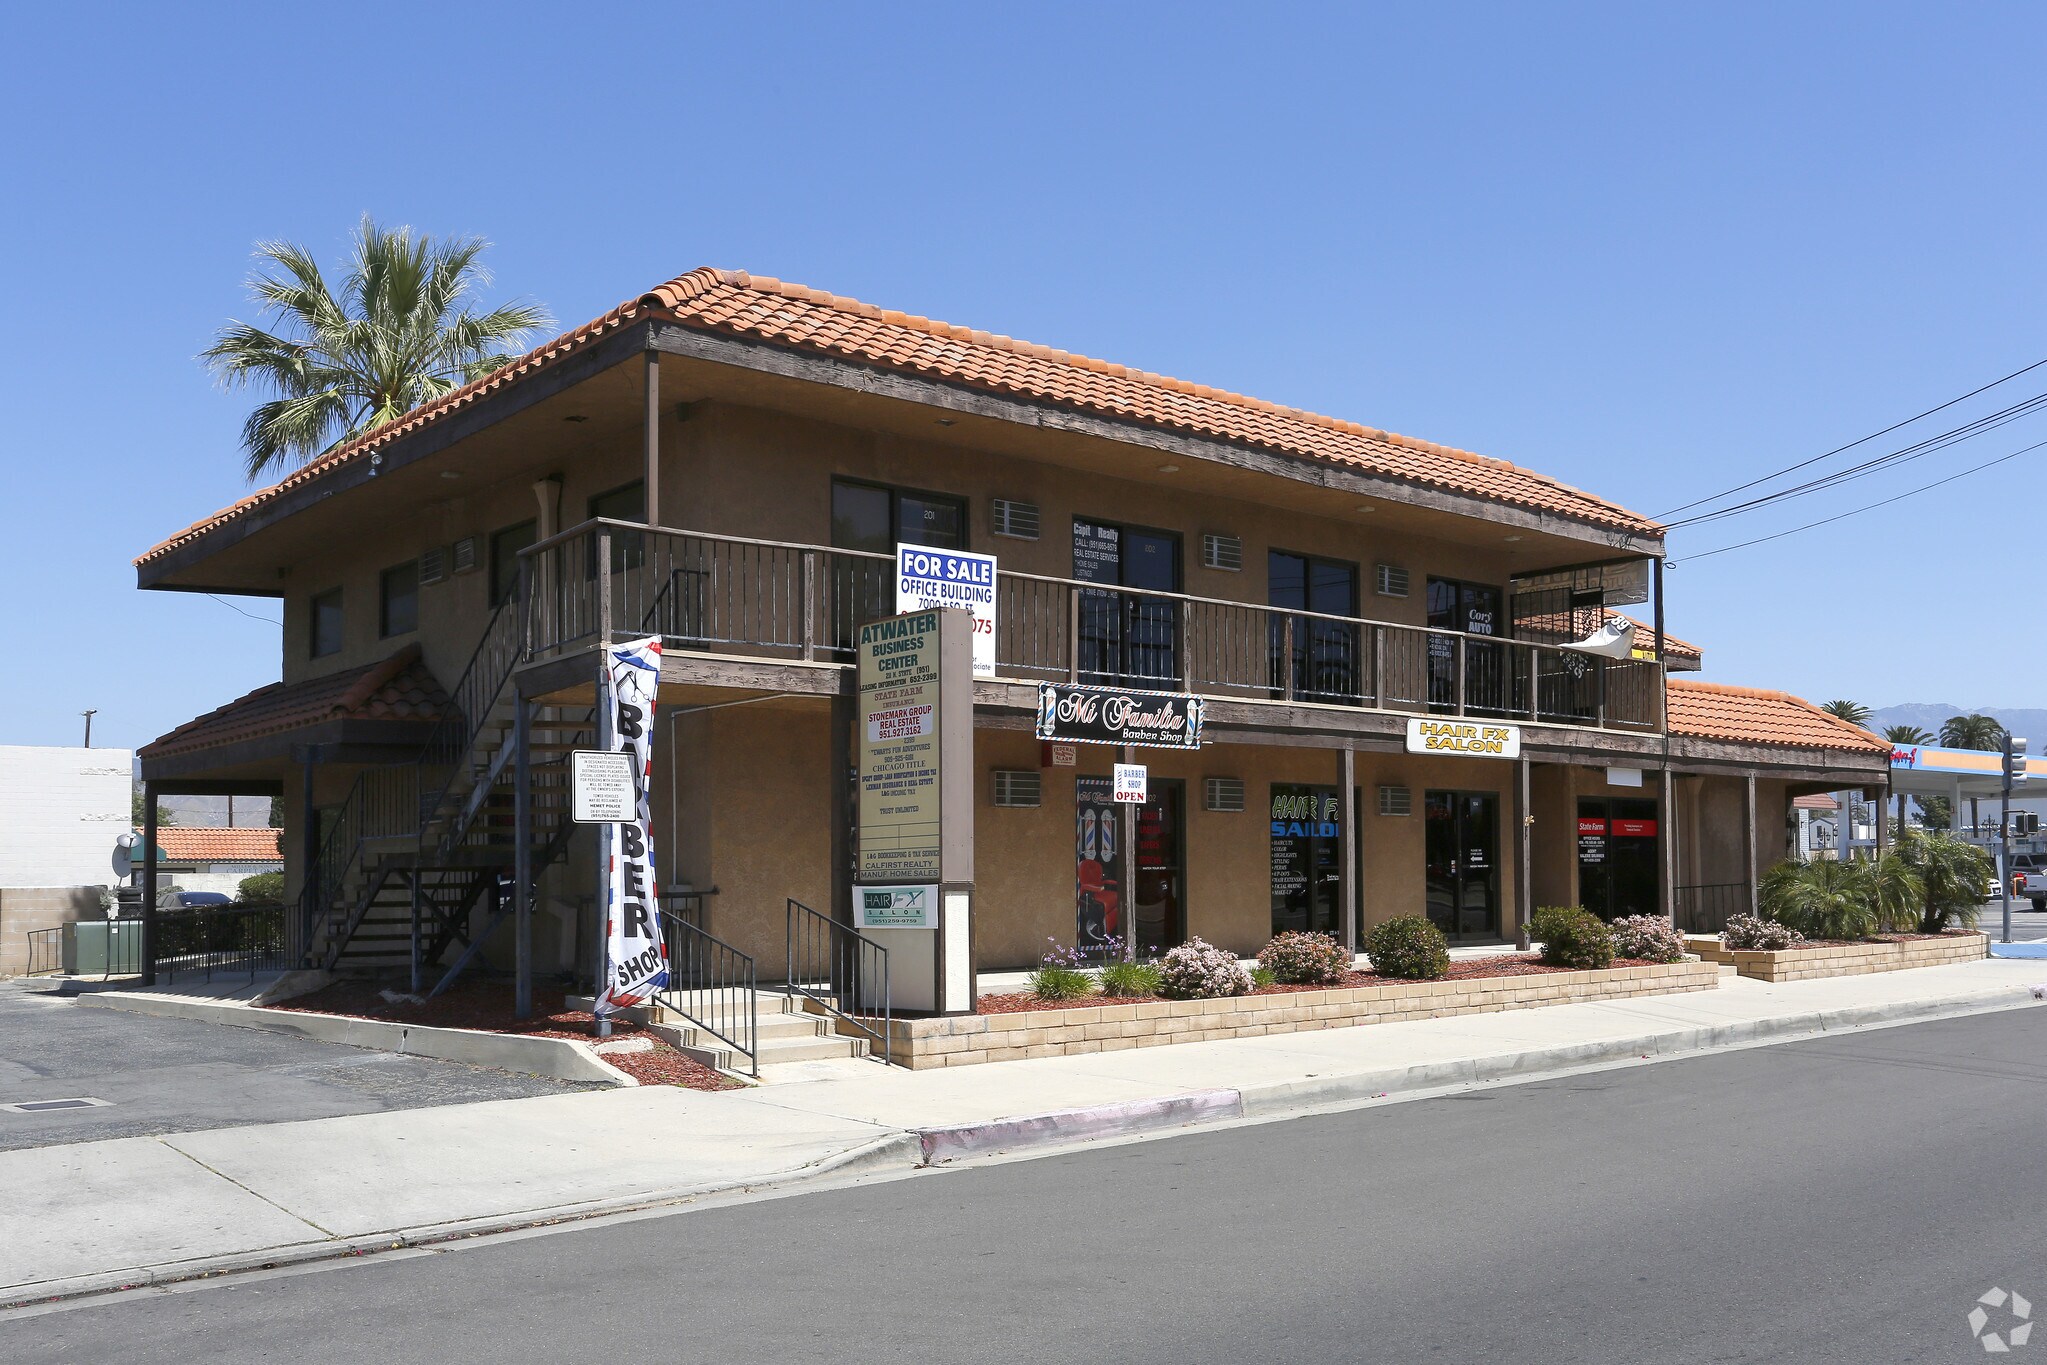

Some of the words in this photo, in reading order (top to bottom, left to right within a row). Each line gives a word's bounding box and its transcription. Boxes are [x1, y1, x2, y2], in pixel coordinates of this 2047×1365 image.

[924, 510, 935, 520] 201
[1098, 527, 1118, 542] Realty
[1074, 549, 1084, 558] REAL
[1085, 550, 1099, 560] ESTATE
[1100, 552, 1118, 562] SERVICES
[904, 553, 942, 577] FOR
[946, 559, 990, 583] SALE
[901, 578, 937, 597] OFFICE
[941, 583, 992, 603] BUILDING
[918, 598, 940, 609] 7000
[861, 613, 936, 644] ATWATER
[1469, 622, 1492, 634] AUTO
[872, 636, 924, 657] BUSINESS
[878, 654, 918, 671] CENTER
[898, 669, 912, 677] STATE
[917, 665, 930, 674] (951)
[878, 678, 906, 688] INFORMATION
[910, 673, 937, 684] 652-2399
[874, 690, 897, 701] STATE
[900, 686, 923, 698] FARM
[883, 699, 915, 708] INSURANCE
[869, 708, 908, 722] STONEMARK
[909, 705, 932, 716] GROUP
[1058, 693, 1100, 724] Mi
[1103, 696, 1185, 731] Familia
[880, 718, 897, 730] REAL
[898, 716, 920, 727] ESTATE
[879, 726, 921, 739] 951.927.3162
[1122, 728, 1158, 740] Barber
[1160, 731, 1182, 744] Shop
[1420, 723, 1477, 738] HAIR
[1482, 728, 1509, 740] FX
[902, 744, 930, 752] ADVENTURES
[1426, 737, 1502, 753] SALON
[873, 763, 904, 772] CHICAGO
[906, 760, 926, 768] TITLE
[1124, 769, 1145, 778] BARBER
[1128, 780, 1141, 788] SHOP
[1116, 792, 1144, 801] OPEN
[1272, 795, 1318, 820] HAIR
[617, 702, 653, 940] BBER
[1579, 822, 1592, 830] State
[865, 895, 890, 907] HAIR
[892, 890, 923, 908] FX
[618, 946, 659, 987] SHOP
